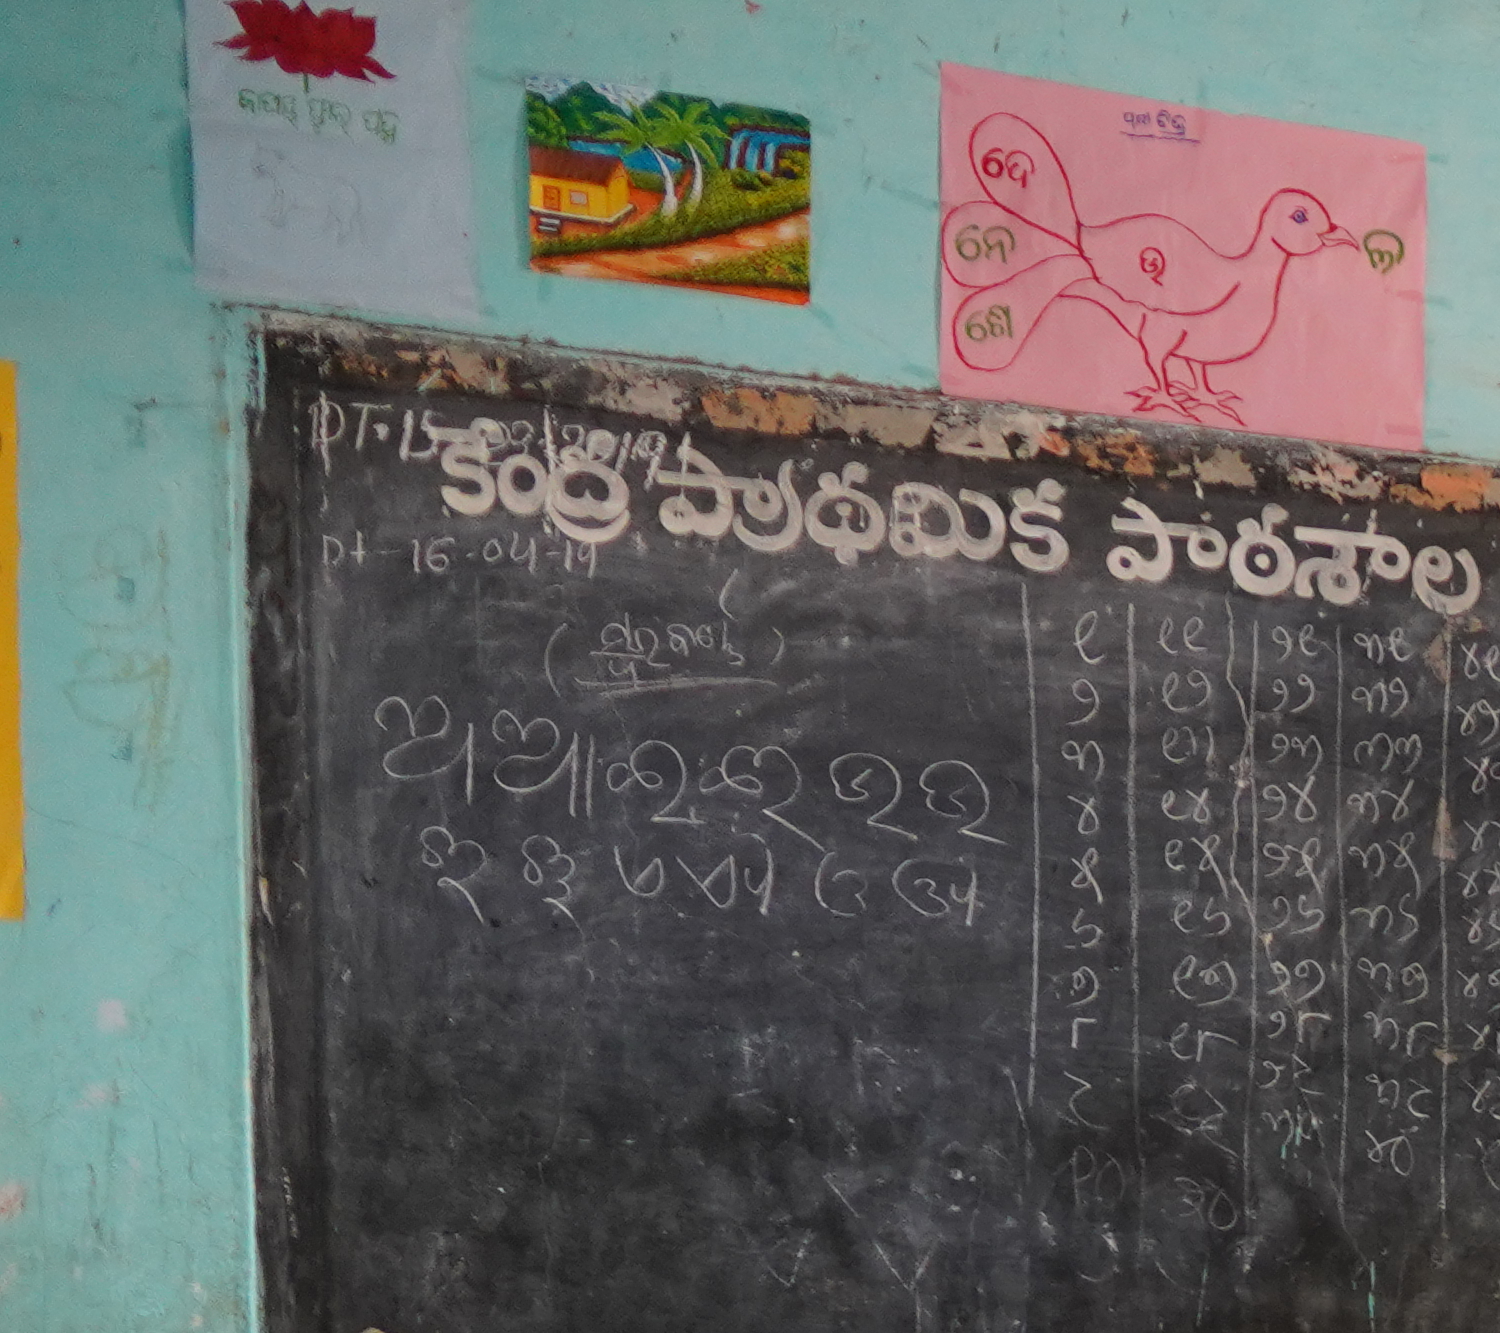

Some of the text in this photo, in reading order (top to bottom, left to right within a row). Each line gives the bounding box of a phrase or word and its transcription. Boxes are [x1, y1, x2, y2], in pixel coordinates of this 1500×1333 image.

[1073, 610, 1105, 665] ୧
[1156, 615, 1208, 655] ୧୧
[1271, 624, 1320, 661] ୨୧
[1354, 627, 1412, 662] ୩୧
[1067, 669, 1500, 747] ୨ ୧୨ ୨୨ ୩୨ ୪୨
